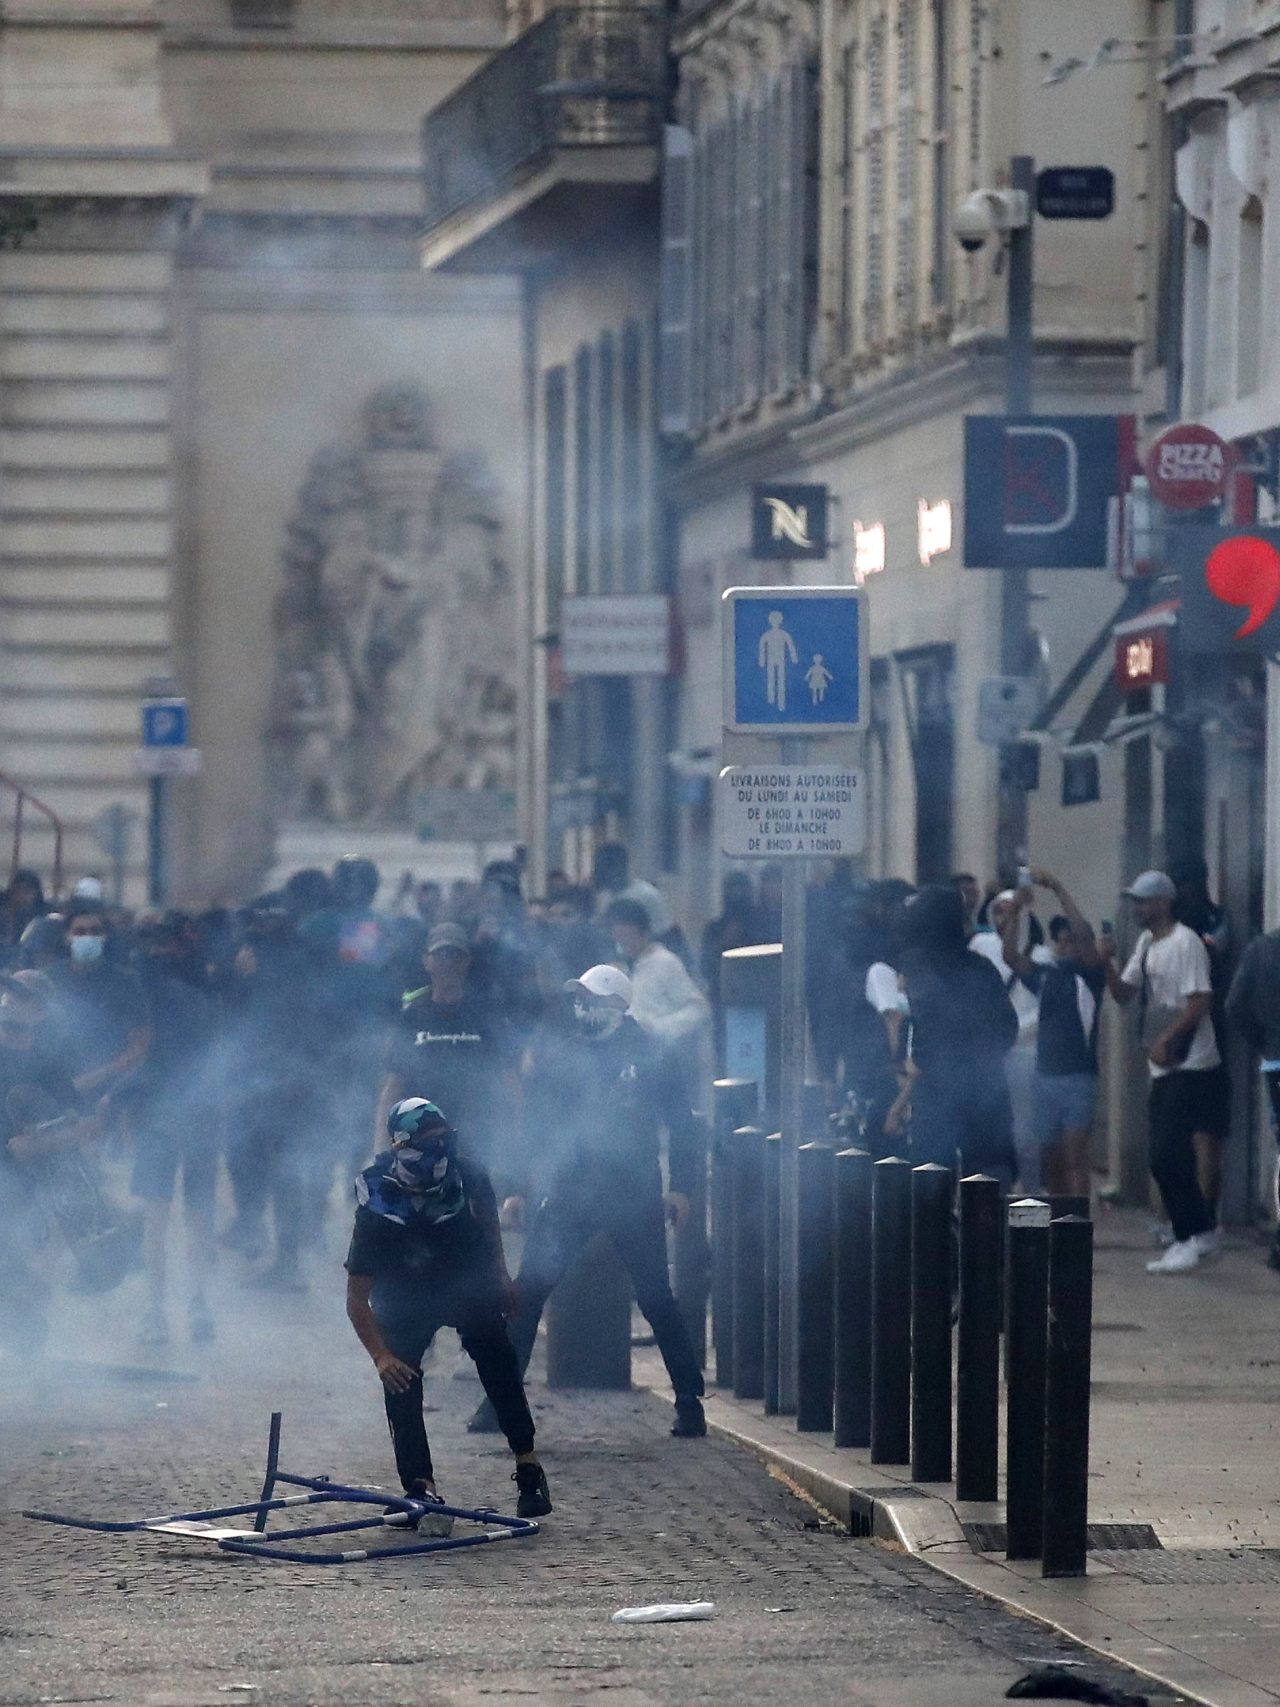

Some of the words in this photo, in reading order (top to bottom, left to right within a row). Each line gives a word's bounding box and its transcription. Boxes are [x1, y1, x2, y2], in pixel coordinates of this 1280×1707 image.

[1161, 444, 1223, 464] PIZZA
[763, 497, 813, 549] N
[730, 775, 791, 788] LIVRAISONS
[738, 790, 752, 802] DU
[758, 790, 789, 802] LUNDI
[793, 790, 808, 802] AU
[813, 790, 852, 802] SAMEDI
[747, 808, 761, 820] DE
[765, 808, 791, 820] 6H00
[796, 808, 804, 820] A
[810, 808, 841, 820] 10H00
[759, 823, 770, 834] LE
[775, 823, 828, 834] DIMANCHE
[748, 838, 761, 850] DE
[796, 838, 804, 850] A
[810, 838, 842, 850] 10H00
[414, 1031, 481, 1045] Champion
